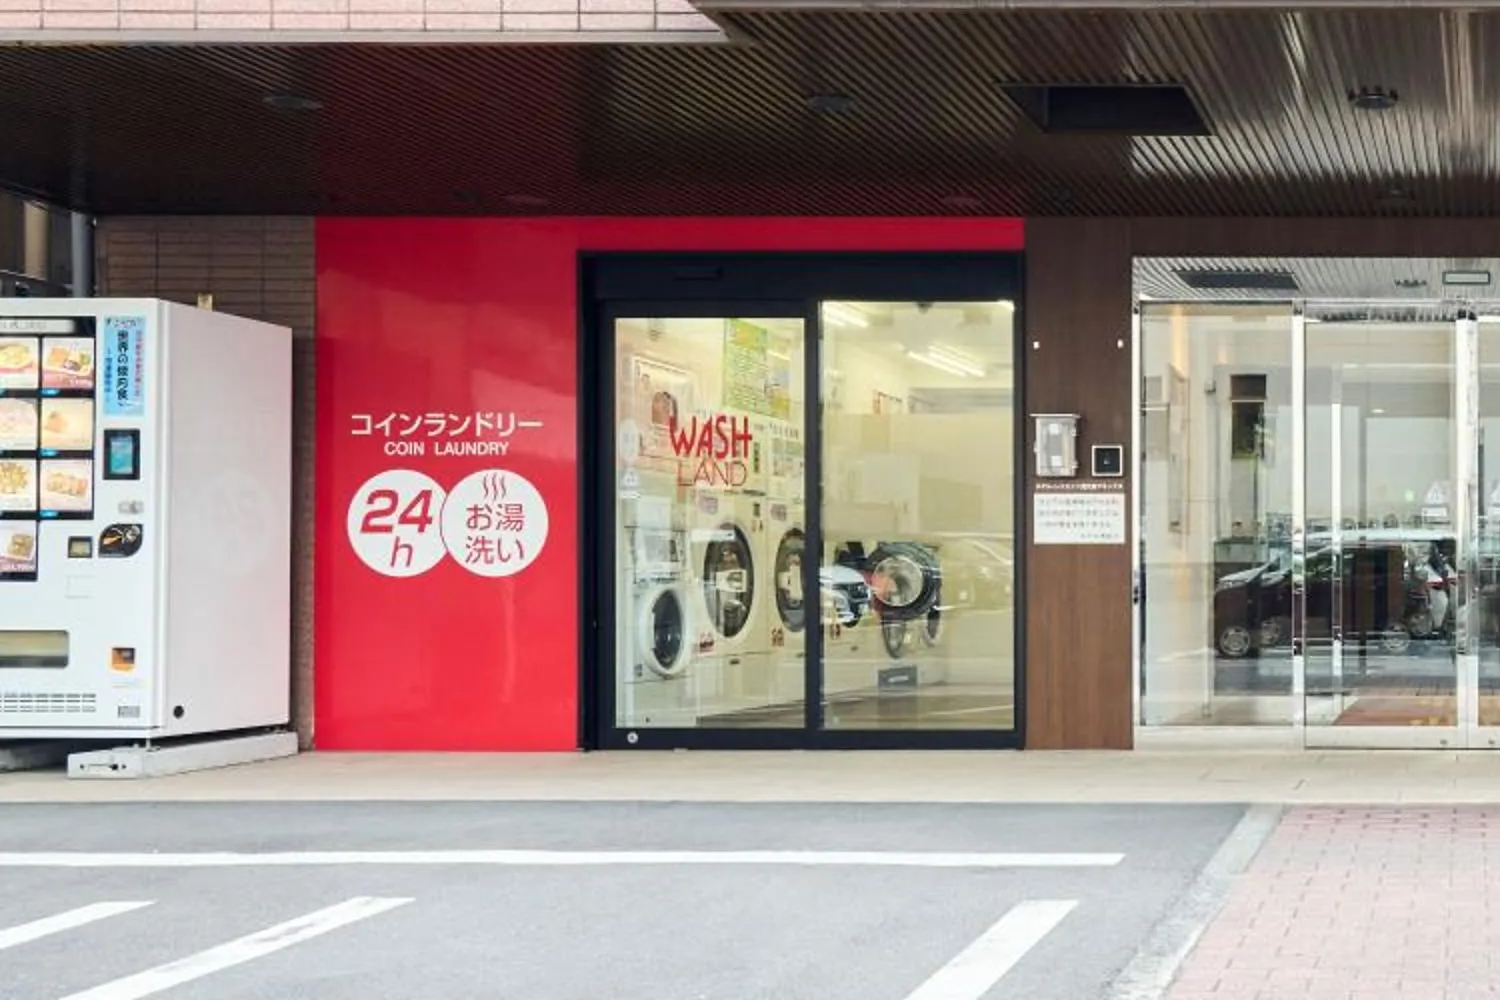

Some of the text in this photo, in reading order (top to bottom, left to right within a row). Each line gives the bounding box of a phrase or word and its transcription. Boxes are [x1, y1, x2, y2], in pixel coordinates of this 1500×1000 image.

[351, 411, 543, 437] コインランドリー
[669, 415, 752, 459] WASH
[384, 441, 509, 456] COIN LAUNDRY
[677, 459, 747, 487] LAND
[360, 489, 433, 534] 24
[466, 503, 525, 532] お湯
[390, 536, 413, 567] h
[465, 535, 525, 565] 洗い
